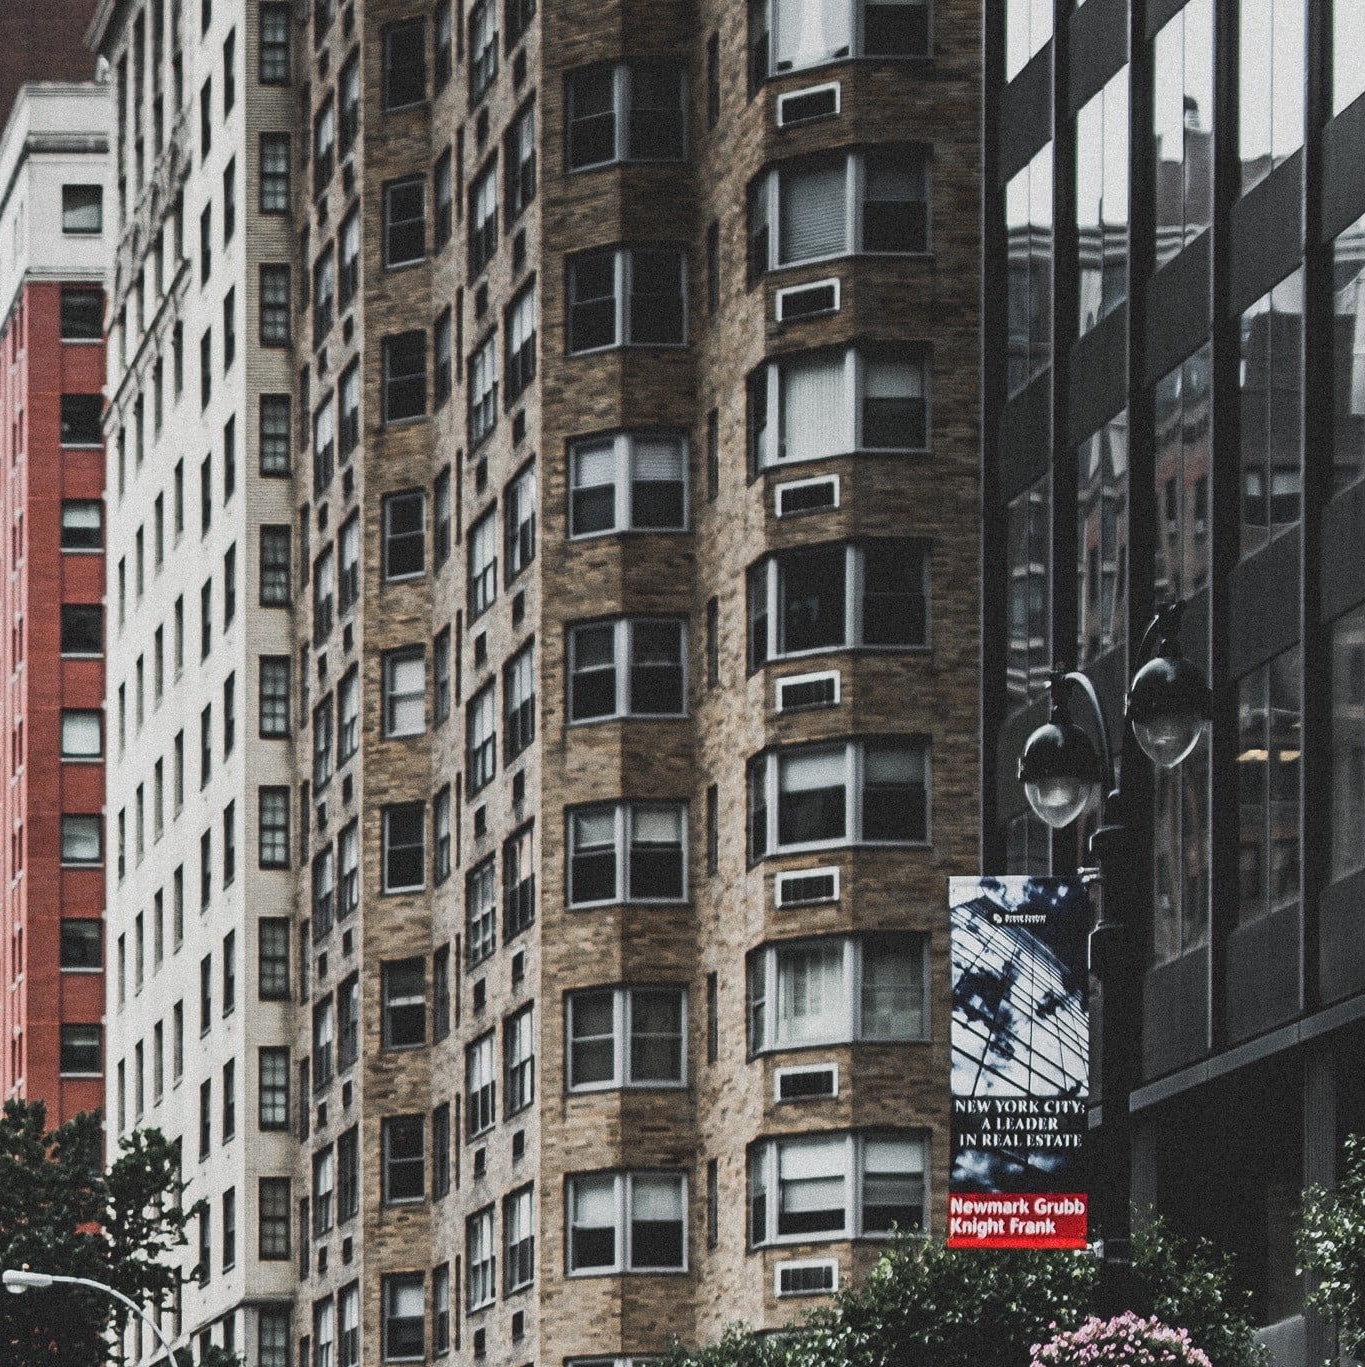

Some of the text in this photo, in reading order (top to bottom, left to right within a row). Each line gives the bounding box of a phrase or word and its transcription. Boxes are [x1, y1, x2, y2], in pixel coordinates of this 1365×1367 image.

[955, 1100, 991, 1113] NEW
[996, 1100, 1039, 1113] YORK
[981, 1117, 1058, 1130] A LEADER
[959, 1133, 1083, 1147] IN REAL ESTATE
[950, 1197, 1086, 1215] Newmark Grubb
[950, 1217, 1056, 1238] Knight Frank
